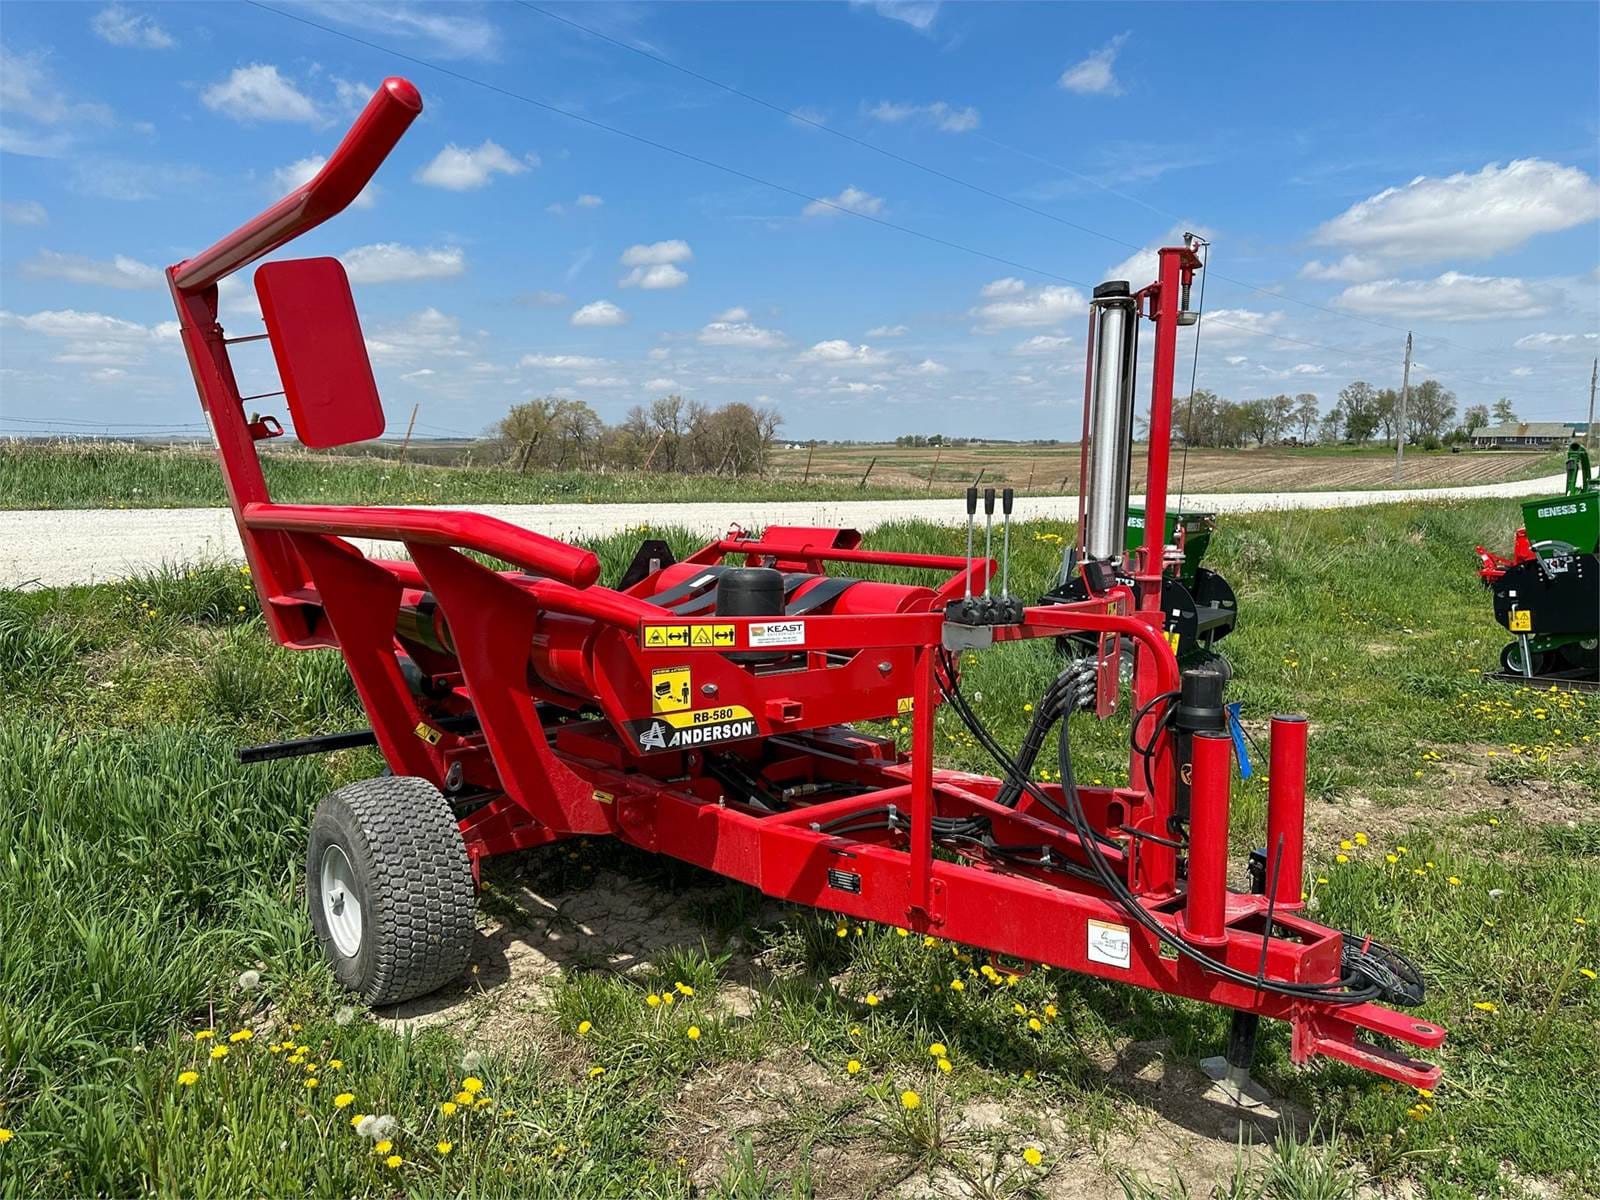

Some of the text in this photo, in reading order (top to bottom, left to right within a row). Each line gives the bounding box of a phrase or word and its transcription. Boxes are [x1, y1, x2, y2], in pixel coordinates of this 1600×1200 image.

[1537, 502, 1587, 518] GENESIS 3
[767, 624, 803, 633] KEAST
[693, 708, 733, 723] RB-580
[668, 721, 752, 747] ANDERSON
